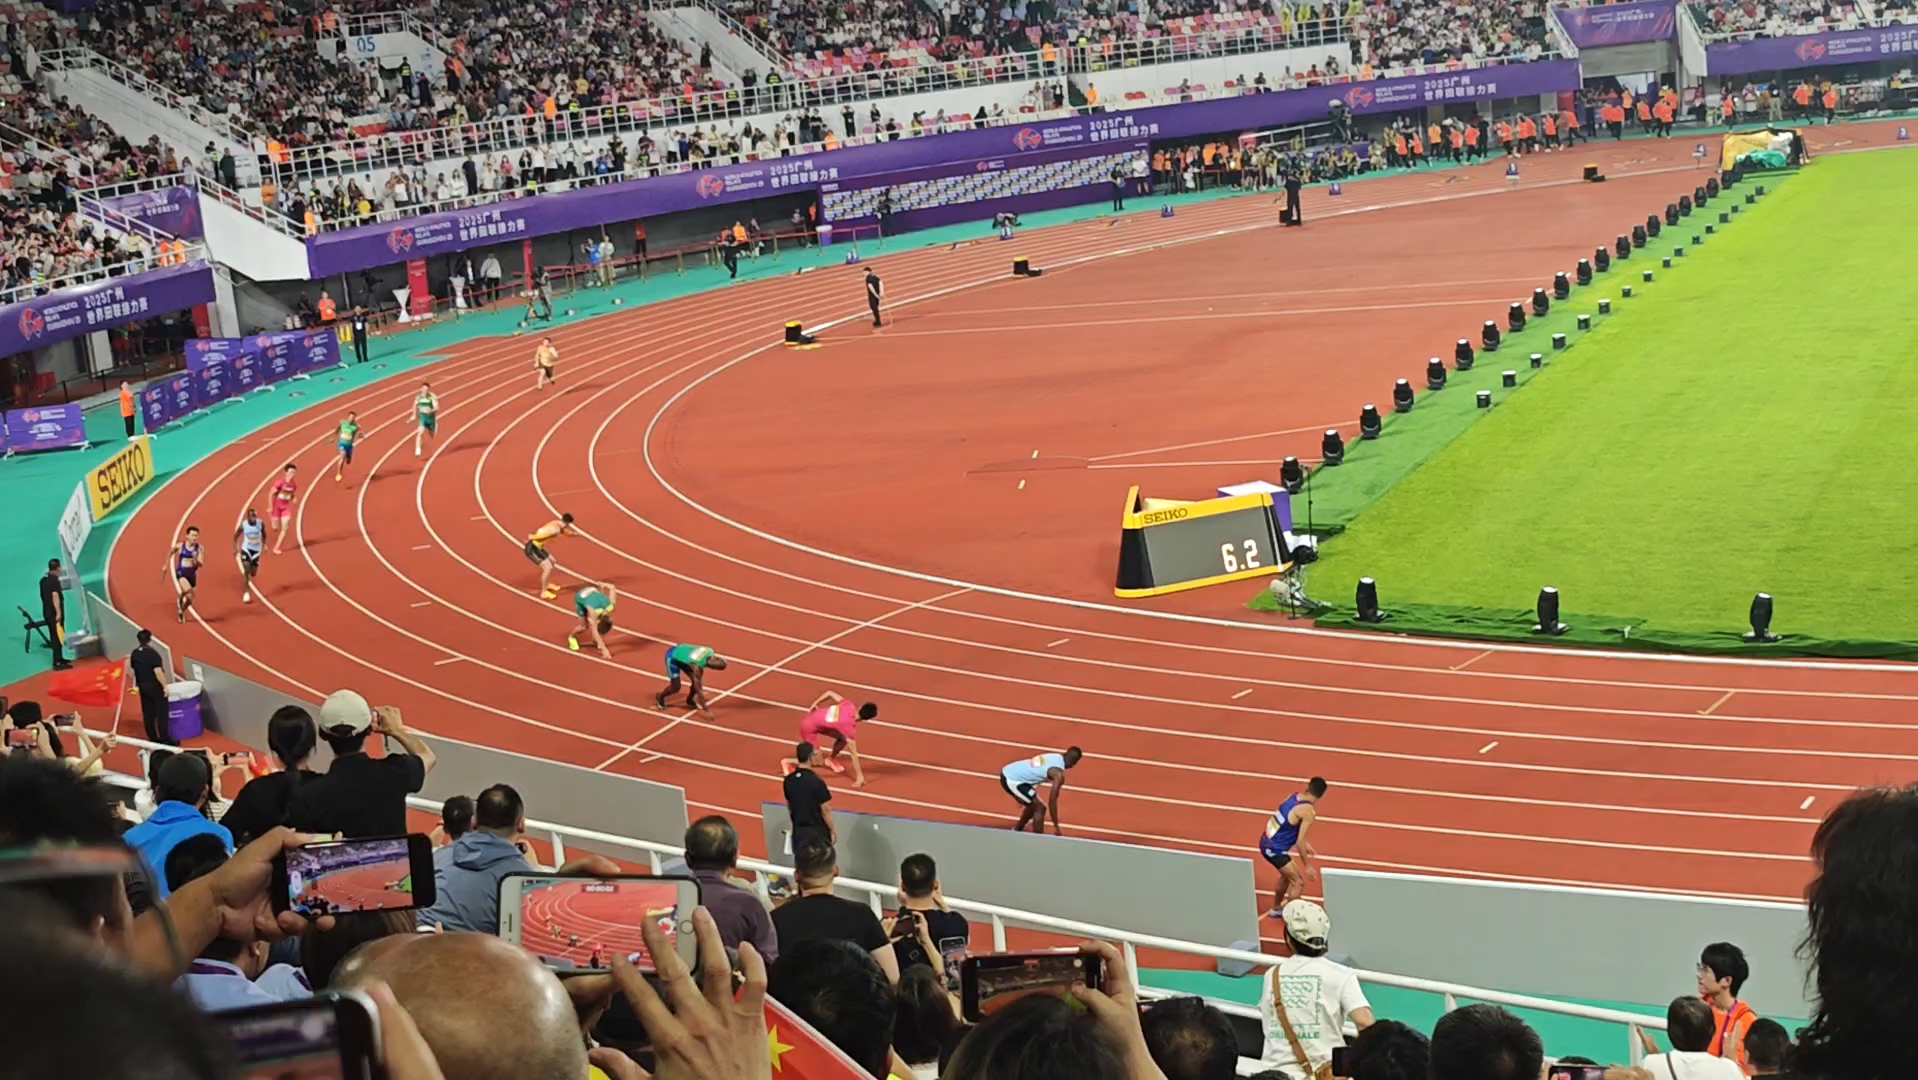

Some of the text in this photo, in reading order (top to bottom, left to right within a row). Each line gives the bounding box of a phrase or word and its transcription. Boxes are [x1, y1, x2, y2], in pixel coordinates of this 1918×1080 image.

[356, 36, 376, 52] 05
[97, 444, 145, 509] SEIKO
[1144, 508, 1188, 524] SEIKO
[1221, 539, 1260, 573] 6.2
